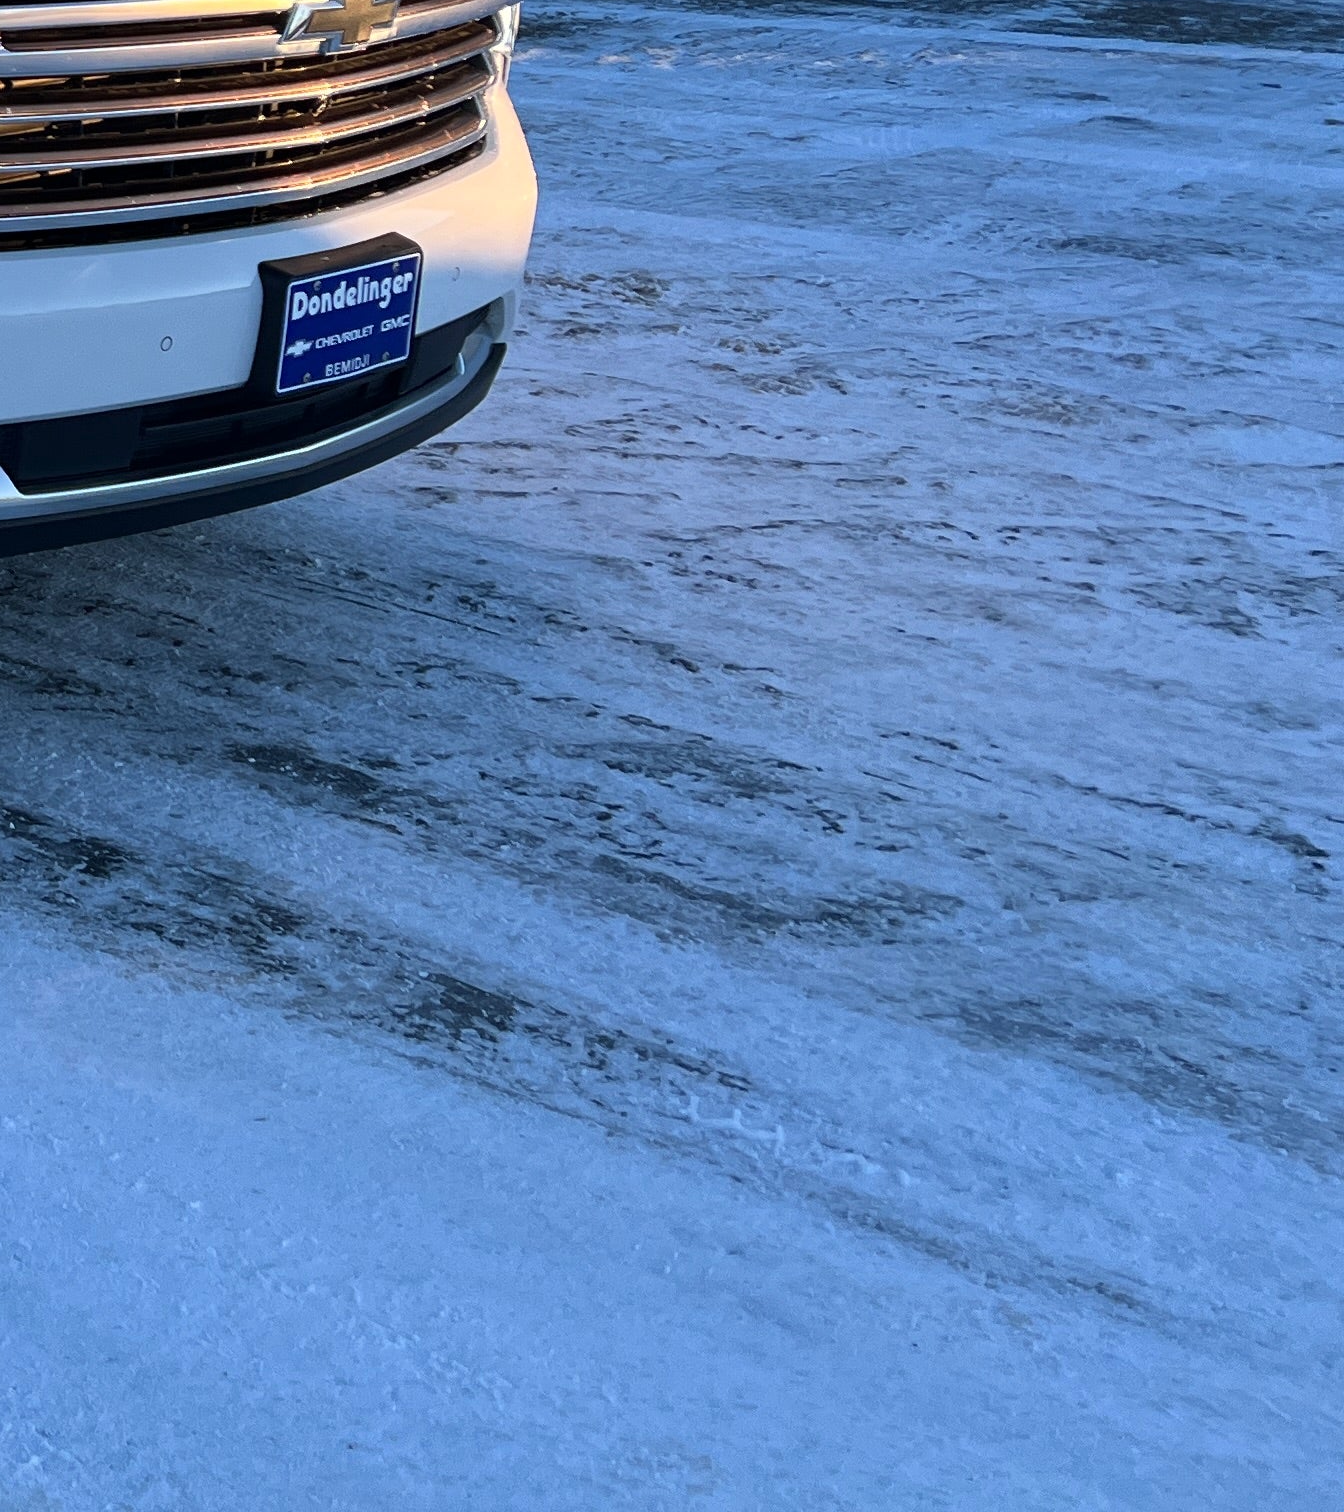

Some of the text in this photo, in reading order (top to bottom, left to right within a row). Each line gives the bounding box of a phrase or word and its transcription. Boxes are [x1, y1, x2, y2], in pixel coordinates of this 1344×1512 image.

[291, 272, 413, 320] Dondelinger
[315, 314, 411, 349] CHEVROLET GMC
[325, 353, 371, 377] BEMIDJI
